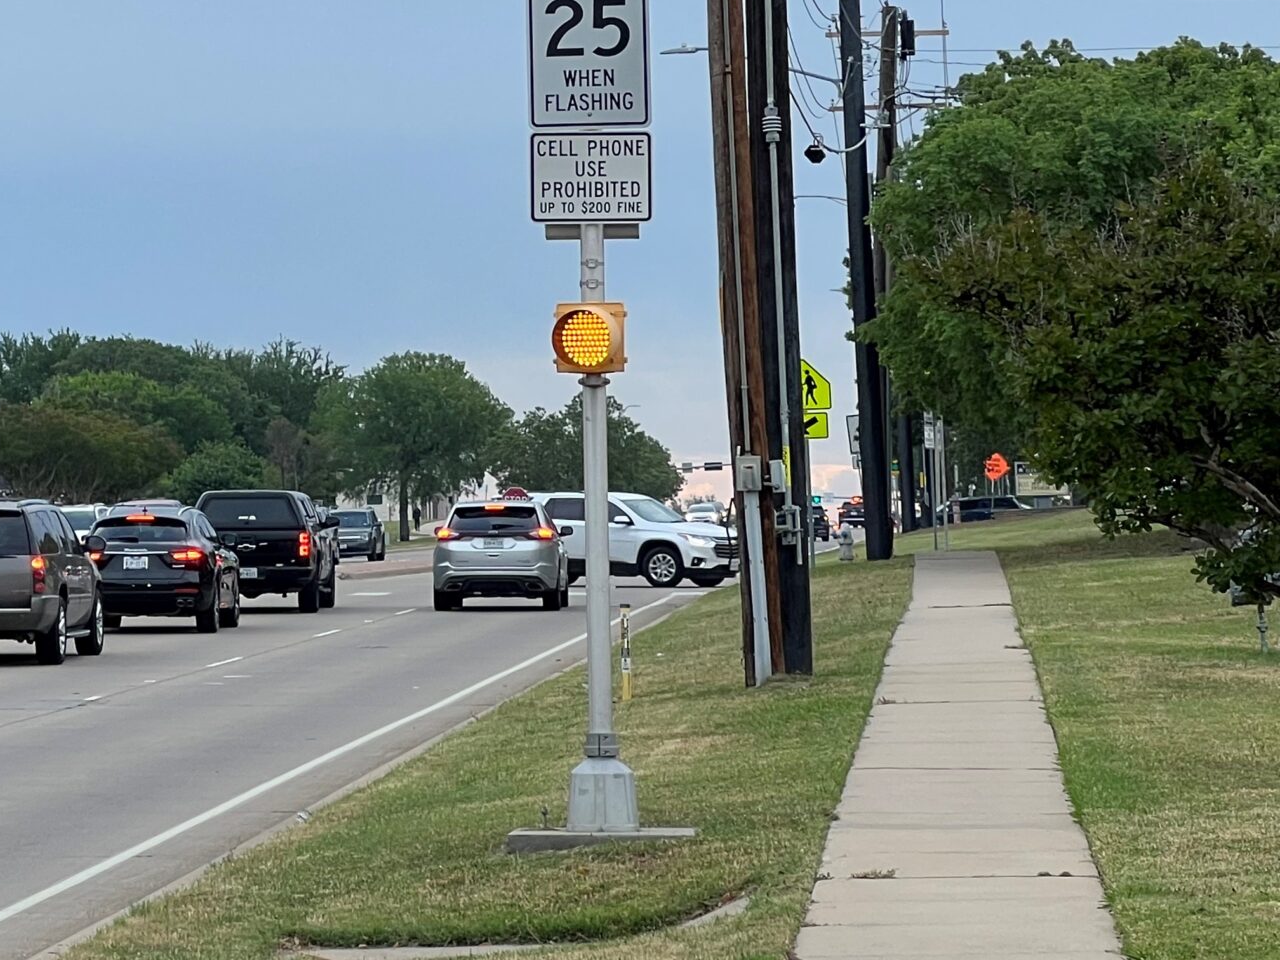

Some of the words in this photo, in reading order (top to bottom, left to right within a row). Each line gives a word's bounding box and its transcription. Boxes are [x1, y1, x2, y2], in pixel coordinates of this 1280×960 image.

[563, 69, 615, 87] WHEN
[545, 92, 634, 112] FLASHING
[536, 139, 578, 157] CELL
[587, 139, 645, 157] PHONE
[575, 160, 607, 177] USE
[541, 181, 641, 198] PROHIBITED
[540, 202, 555, 214] UP
[561, 202, 575, 214] TO
[581, 200, 611, 215] $200
[617, 201, 643, 213] FINE
